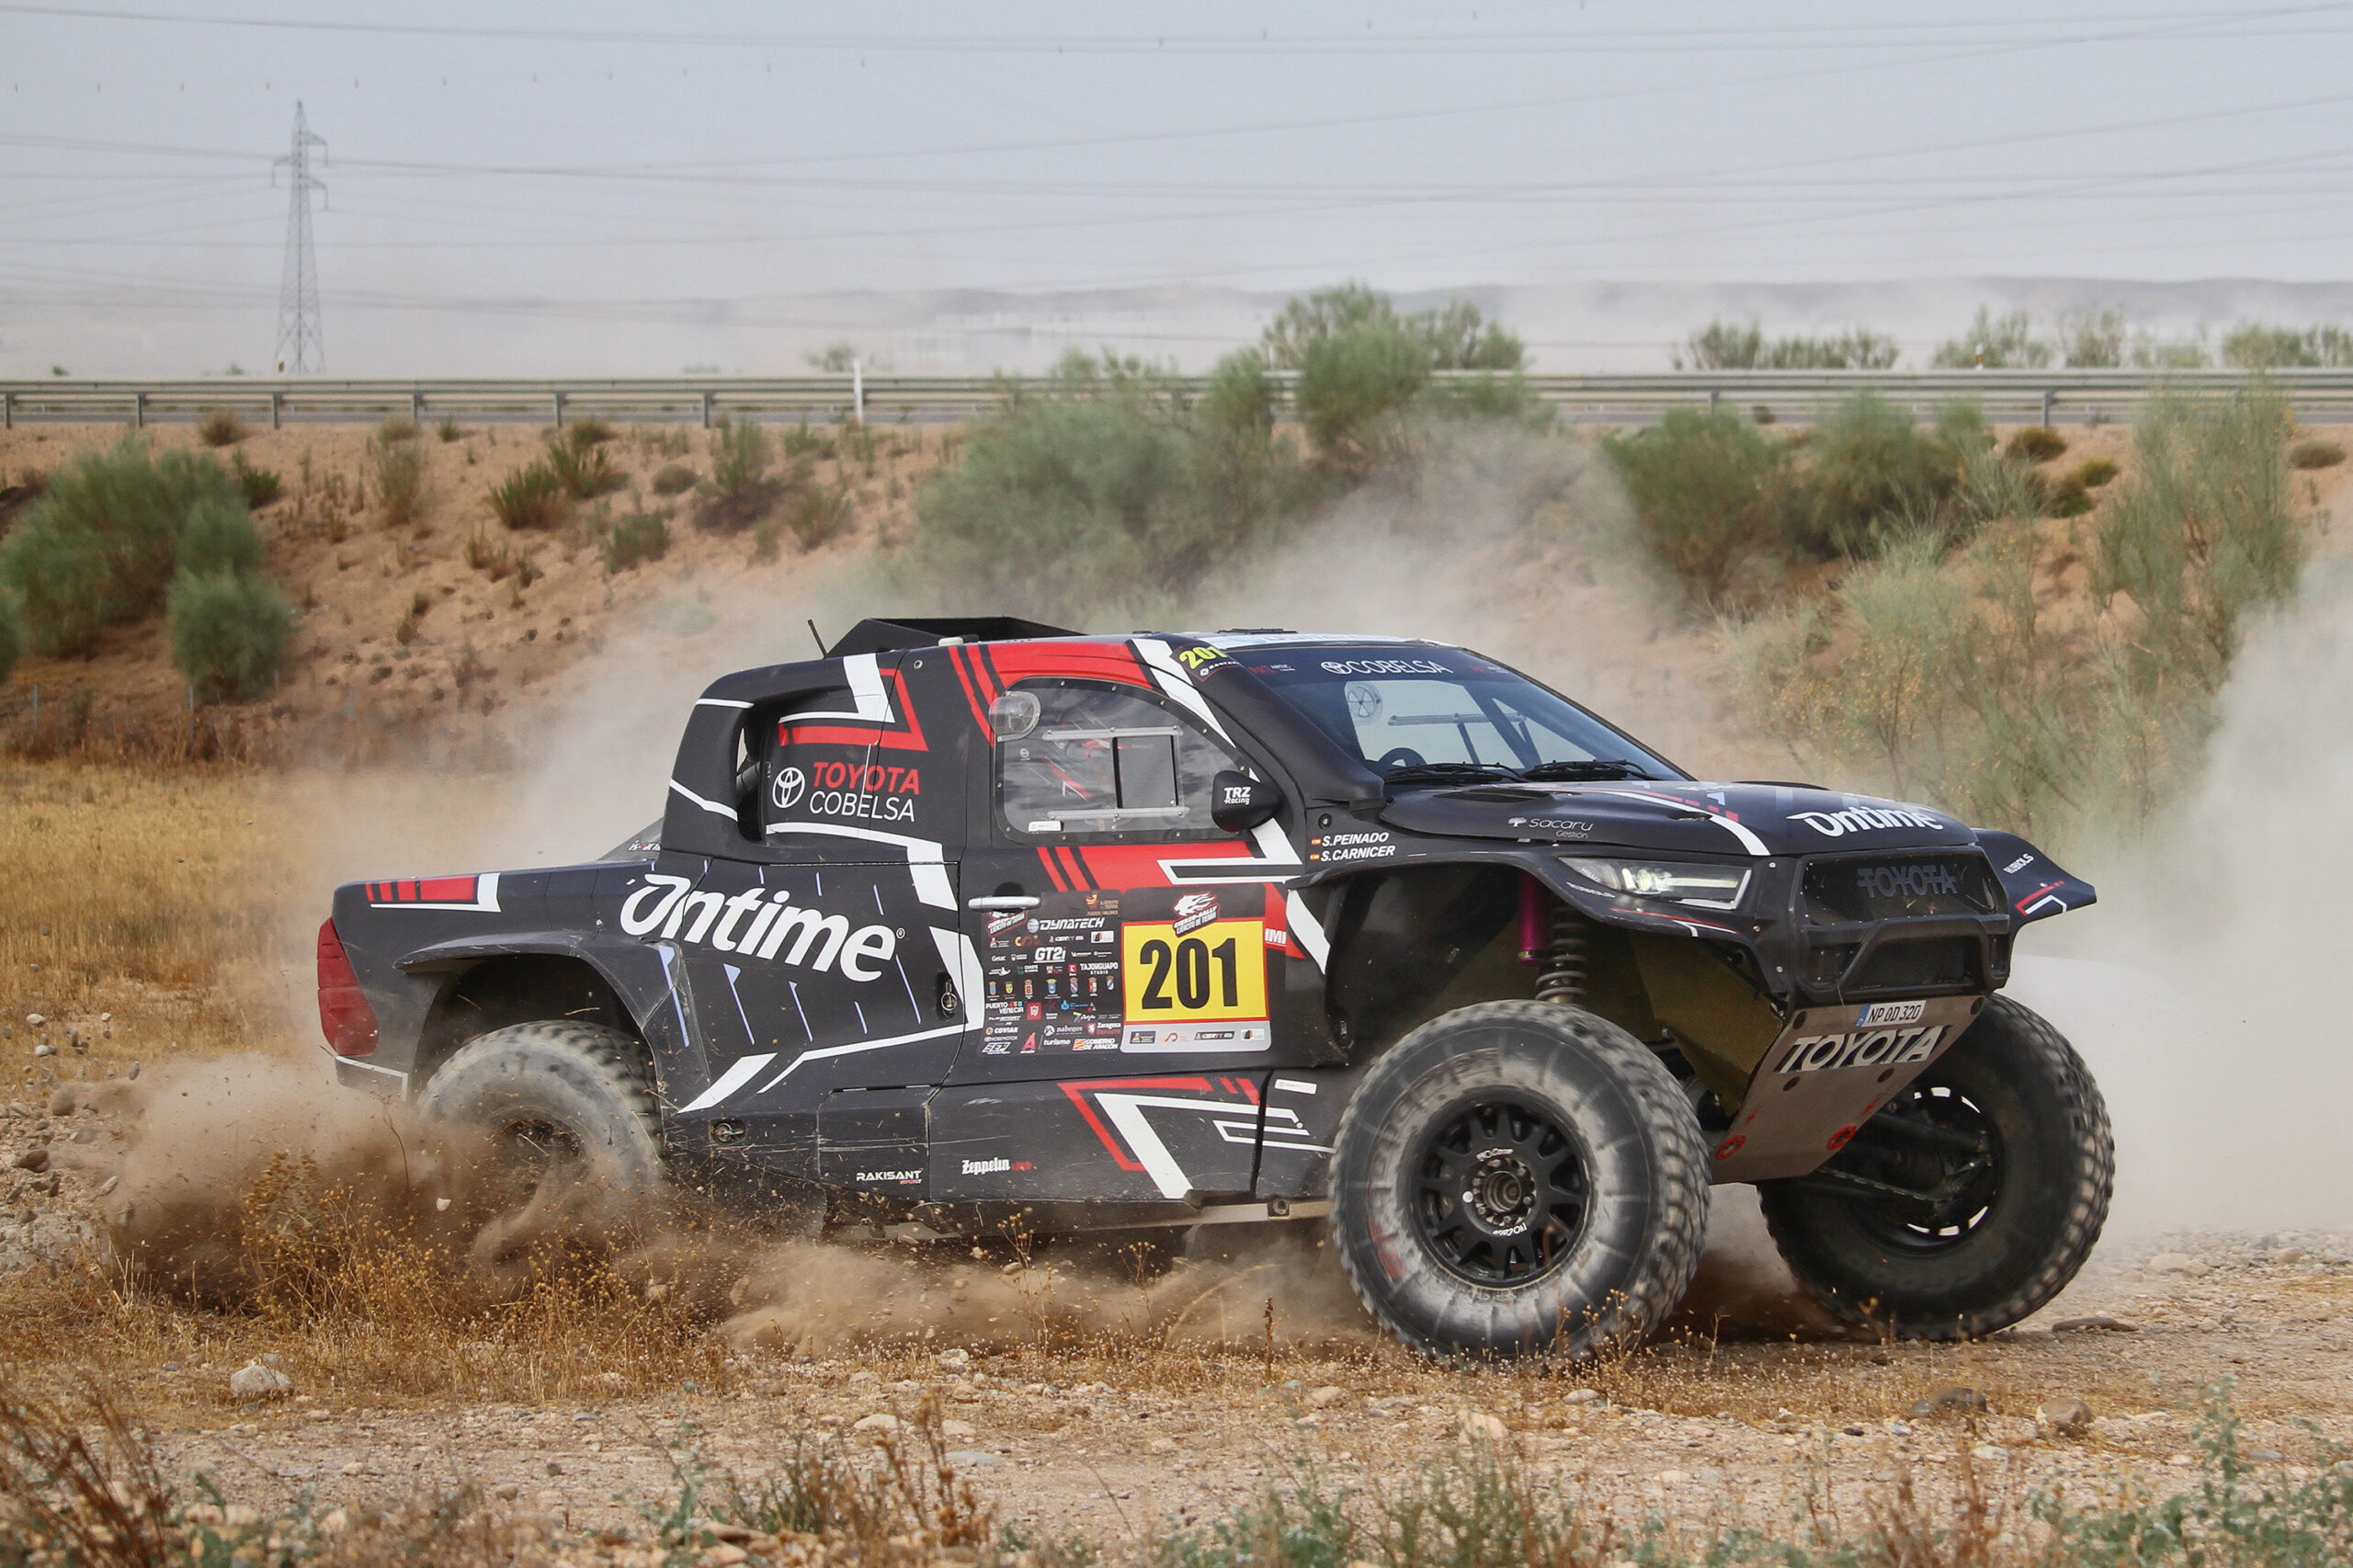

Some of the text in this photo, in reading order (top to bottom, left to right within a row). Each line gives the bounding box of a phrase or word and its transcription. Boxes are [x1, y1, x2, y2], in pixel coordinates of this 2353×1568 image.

[1179, 646, 1228, 669] 201
[1345, 659, 1453, 676] COBELSA
[813, 761, 920, 795] TOYOTA
[1223, 795, 1250, 805] Racing
[1224, 787, 1252, 799] TRZ
[809, 790, 915, 823] COBELSA
[1321, 832, 1390, 847] S.PEINADO
[1320, 845, 1396, 862] S.CARNICER
[1857, 864, 1960, 898] TOYOTA
[1040, 917, 1105, 931] DYNATECH
[1034, 947, 1066, 960] GT2i
[1140, 937, 1238, 1010] 201
[1868, 1007, 1884, 1023] NP
[1899, 1005, 1922, 1020] 320
[1776, 1025, 1946, 1074] TOYOTA
[856, 1170, 922, 1181] RAKISANT
